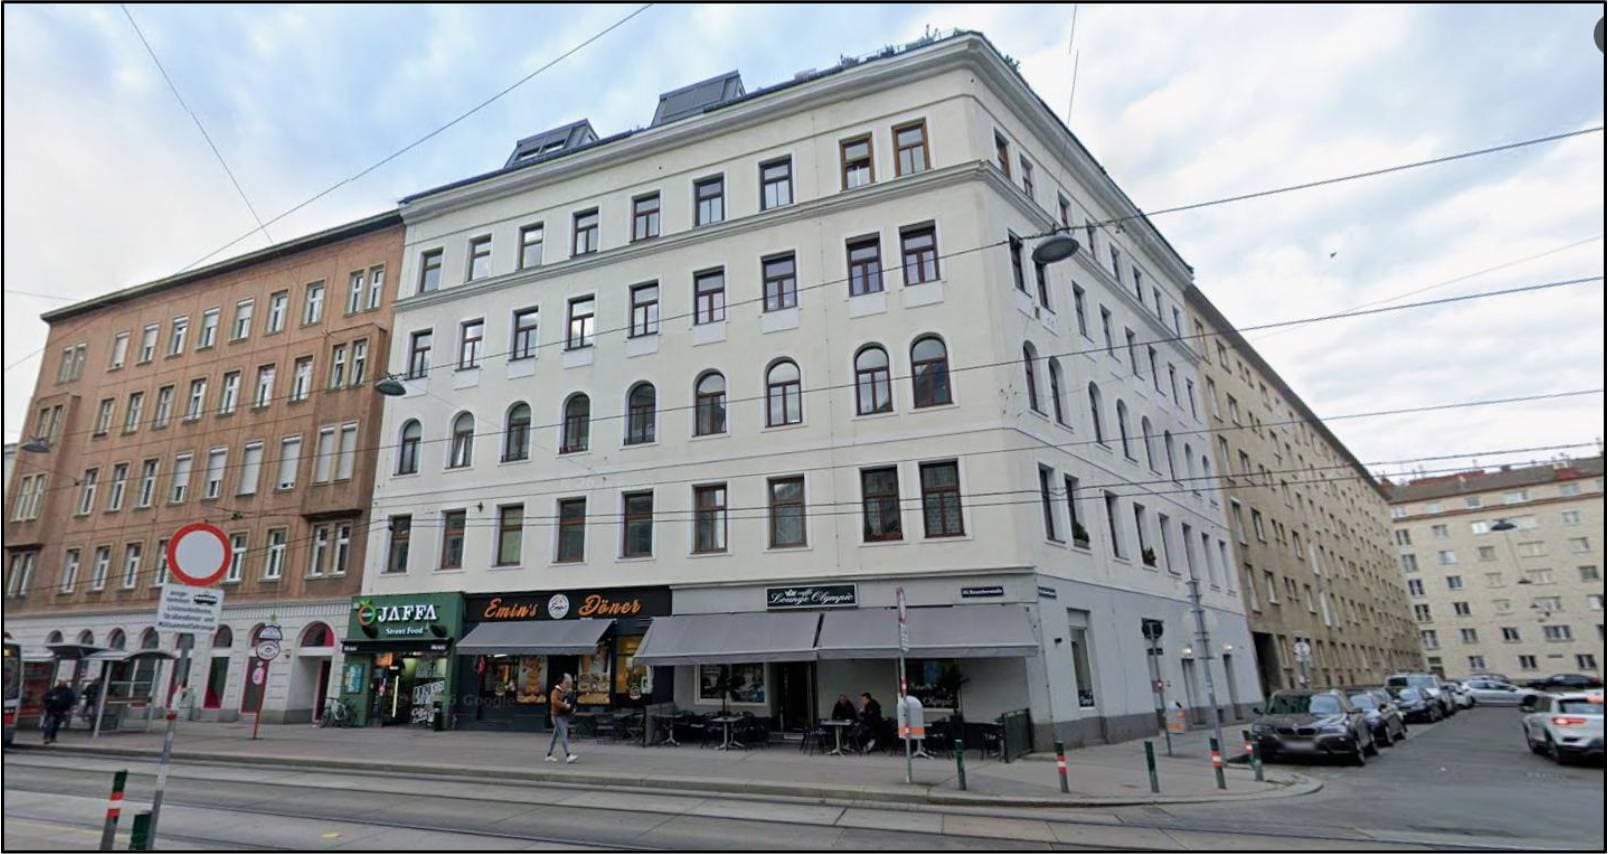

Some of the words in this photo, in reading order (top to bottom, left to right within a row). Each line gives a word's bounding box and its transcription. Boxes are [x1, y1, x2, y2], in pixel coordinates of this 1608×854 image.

[483, 597, 538, 618] Emin's
[578, 594, 641, 617] Döner
[768, 592, 809, 606] Lounge
[811, 590, 854, 605] Olympic
[377, 603, 437, 623] JAFFA
[385, 628, 405, 636] Street
[407, 626, 424, 635] Food
